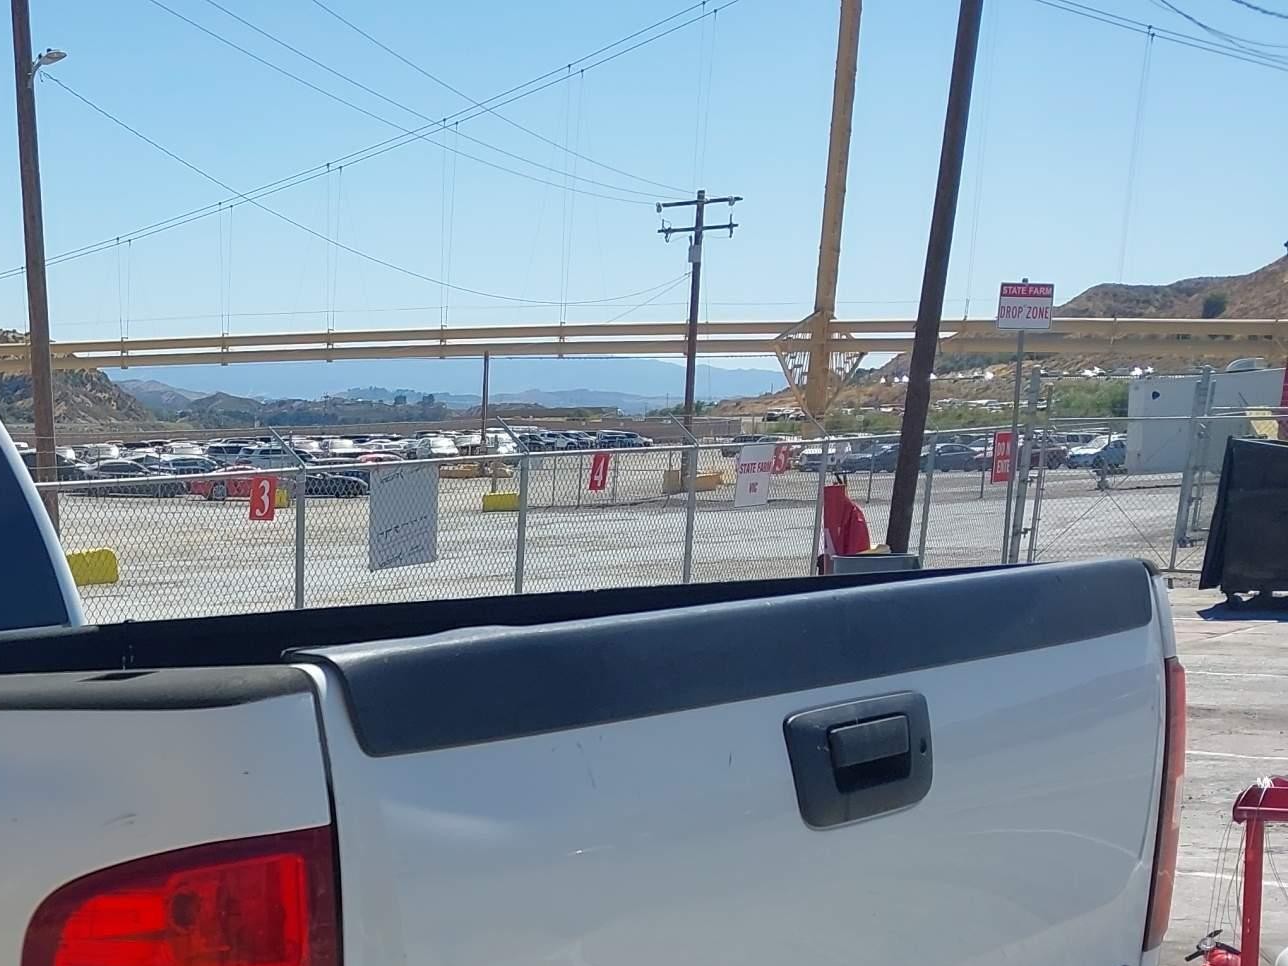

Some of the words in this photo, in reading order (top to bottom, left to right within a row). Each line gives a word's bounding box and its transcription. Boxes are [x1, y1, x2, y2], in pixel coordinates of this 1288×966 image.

[1002, 285, 1027, 295] STATE
[1028, 286, 1052, 296] FARM
[1000, 305, 1023, 319] DROP
[1025, 306, 1049, 320] ZONE
[593, 457, 605, 487] 4
[739, 462, 757, 473] STATE
[255, 479, 270, 517] 3
